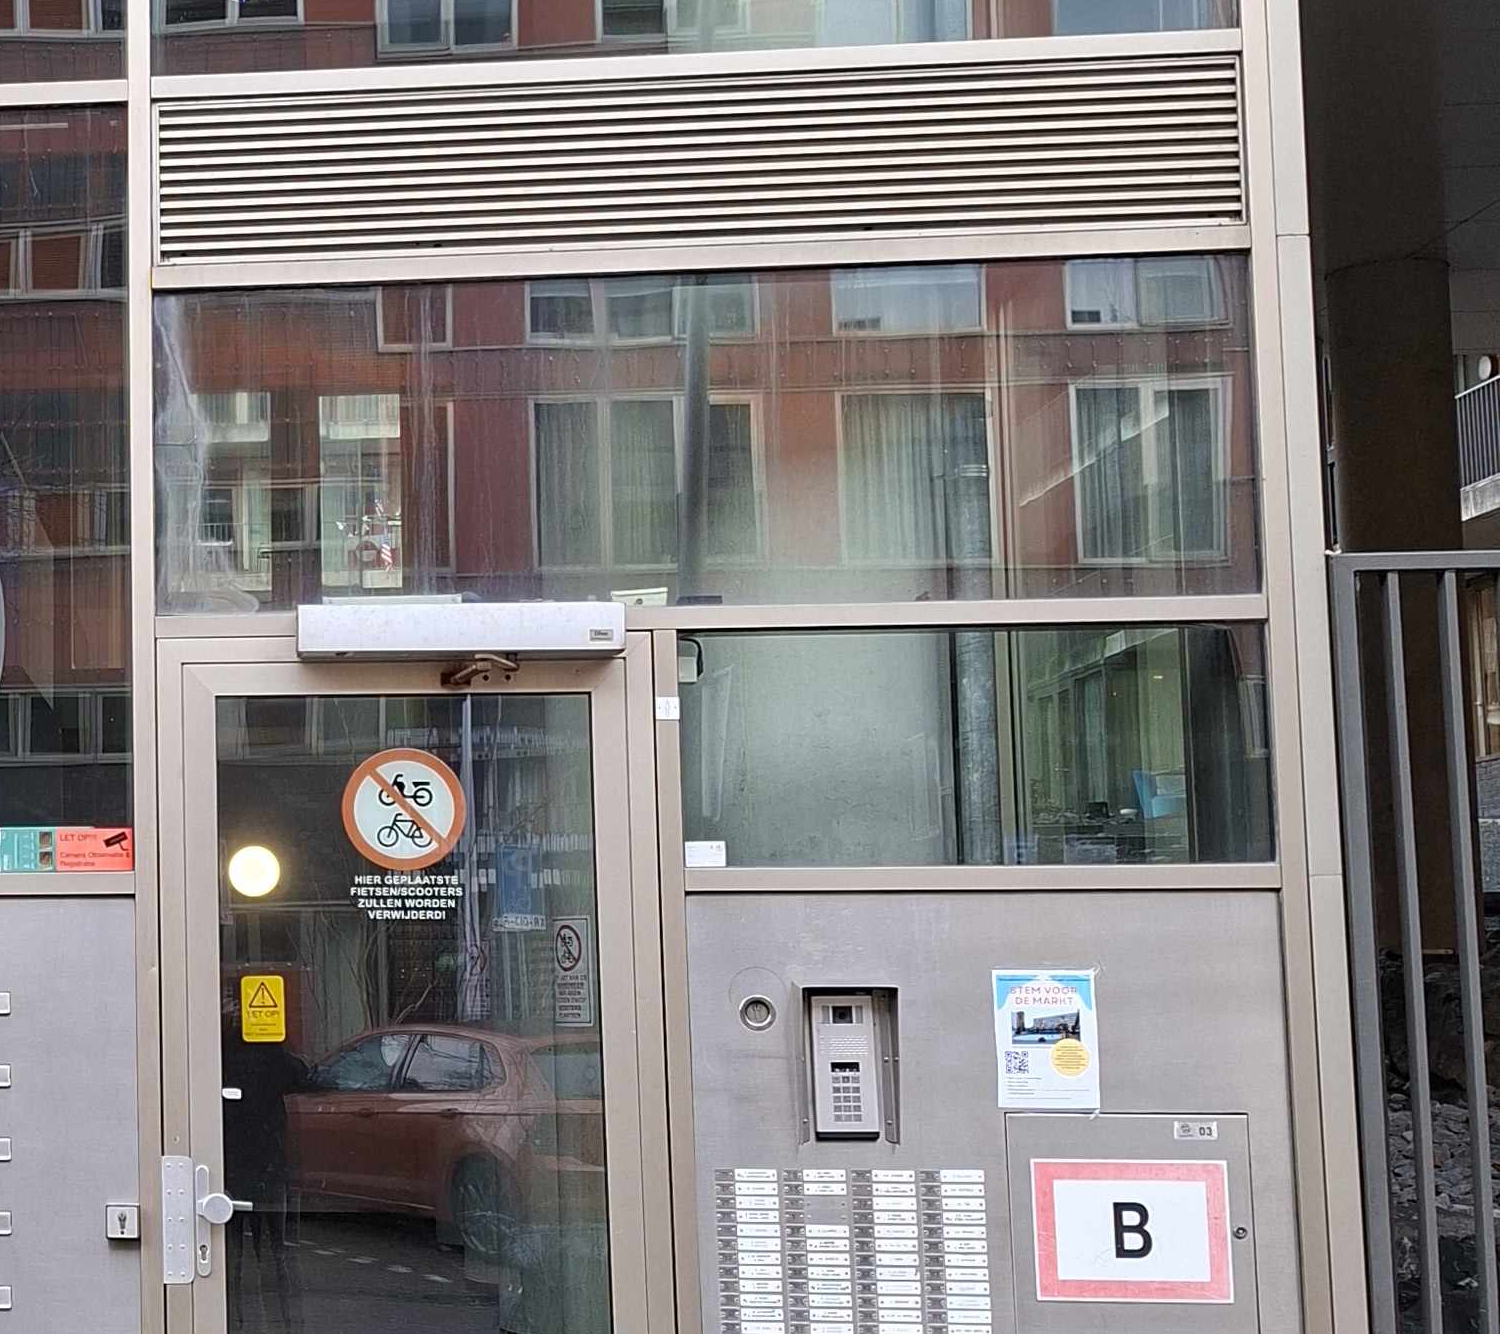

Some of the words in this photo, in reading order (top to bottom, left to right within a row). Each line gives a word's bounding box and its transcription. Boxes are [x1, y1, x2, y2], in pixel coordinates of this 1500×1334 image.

[354, 875, 382, 885] HIER
[384, 875, 459, 885] GEPLAATSTE
[350, 887, 463, 897] FIETSEN/SCOOTERS
[357, 898, 402, 908] ZULLEN
[404, 898, 456, 908] WORDEN
[367, 910, 446, 920] VERWIJDERD!
[1010, 986, 1041, 995] STEM
[1044, 986, 1077, 995] VOOR
[1015, 996, 1030, 1005] DE
[1032, 996, 1074, 1006] MARKT
[1198, 1126, 1213, 1136] 03
[1112, 1201, 1153, 1259] B
